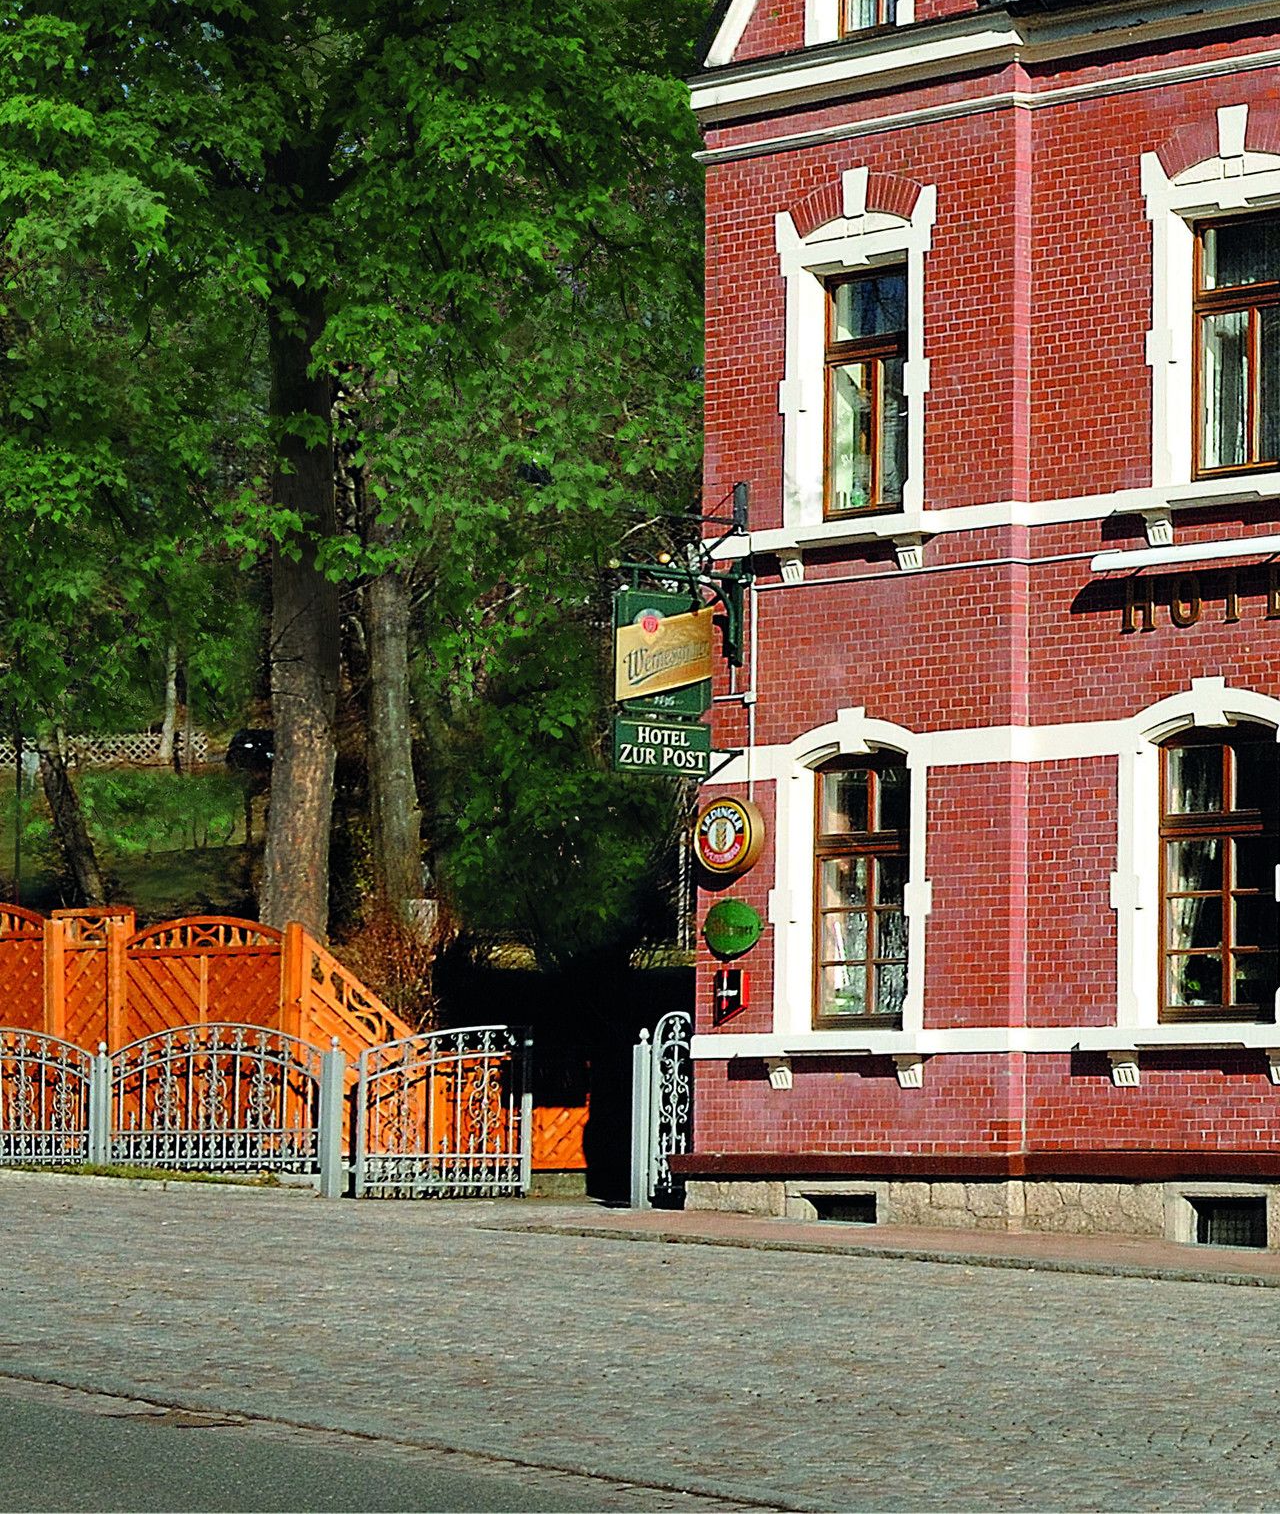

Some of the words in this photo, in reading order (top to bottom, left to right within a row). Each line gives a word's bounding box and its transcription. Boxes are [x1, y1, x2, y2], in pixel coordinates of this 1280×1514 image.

[637, 726, 691, 747] HOTEL
[619, 743, 657, 765] ZUR
[662, 747, 707, 769] POST
